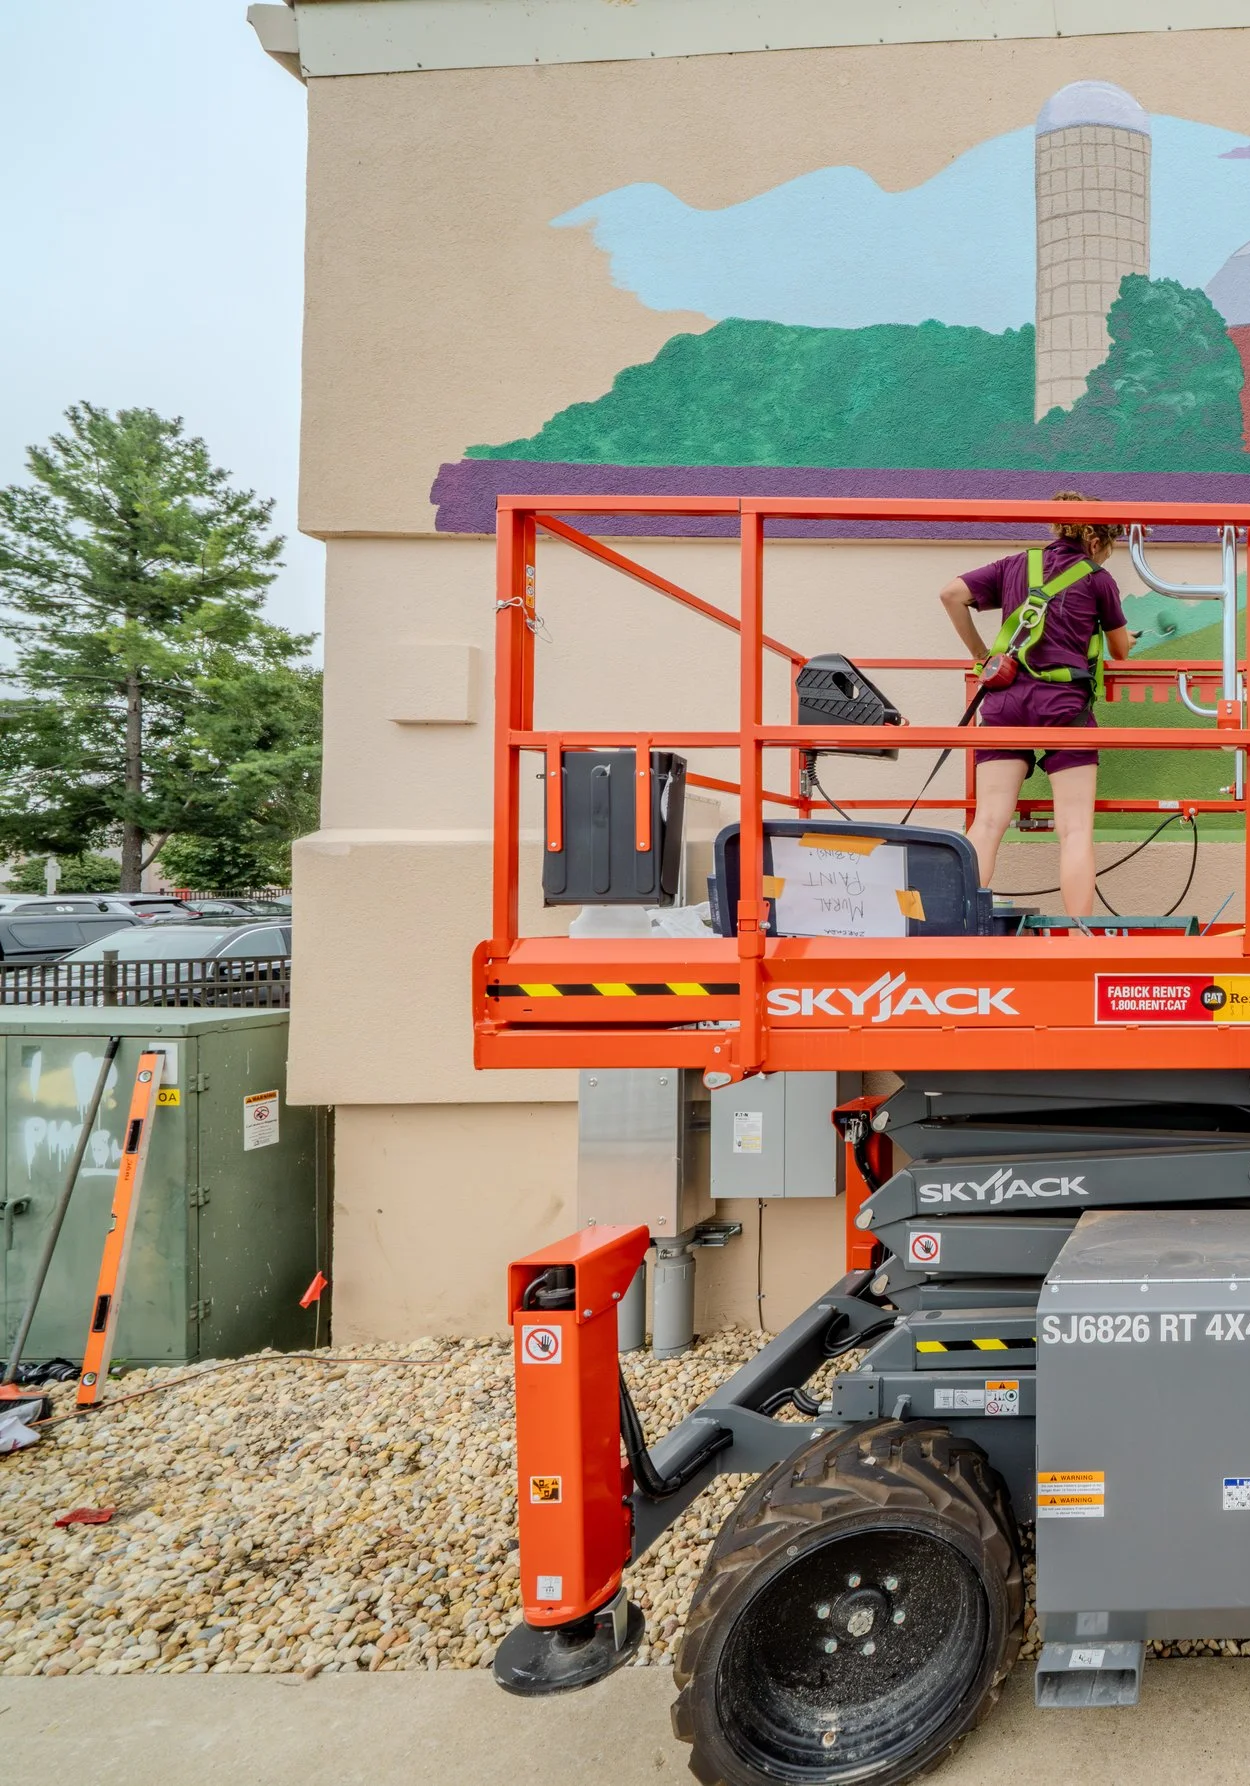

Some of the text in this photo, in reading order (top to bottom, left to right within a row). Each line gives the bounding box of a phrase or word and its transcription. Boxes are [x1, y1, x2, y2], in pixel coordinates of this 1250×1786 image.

[802, 870, 866, 895] PAINT
[814, 898, 864, 922] MURAL
[766, 971, 1020, 1023] SKYJACK
[1107, 986, 1191, 998] FABICK RENTS
[1203, 992, 1223, 1004] CAT
[1110, 999, 1187, 1011] 1.800.RENT.CAT
[919, 1167, 1089, 1205] SKYJACK
[1042, 1315, 1150, 1344] SJ6826
[1160, 1314, 1197, 1342] RT
